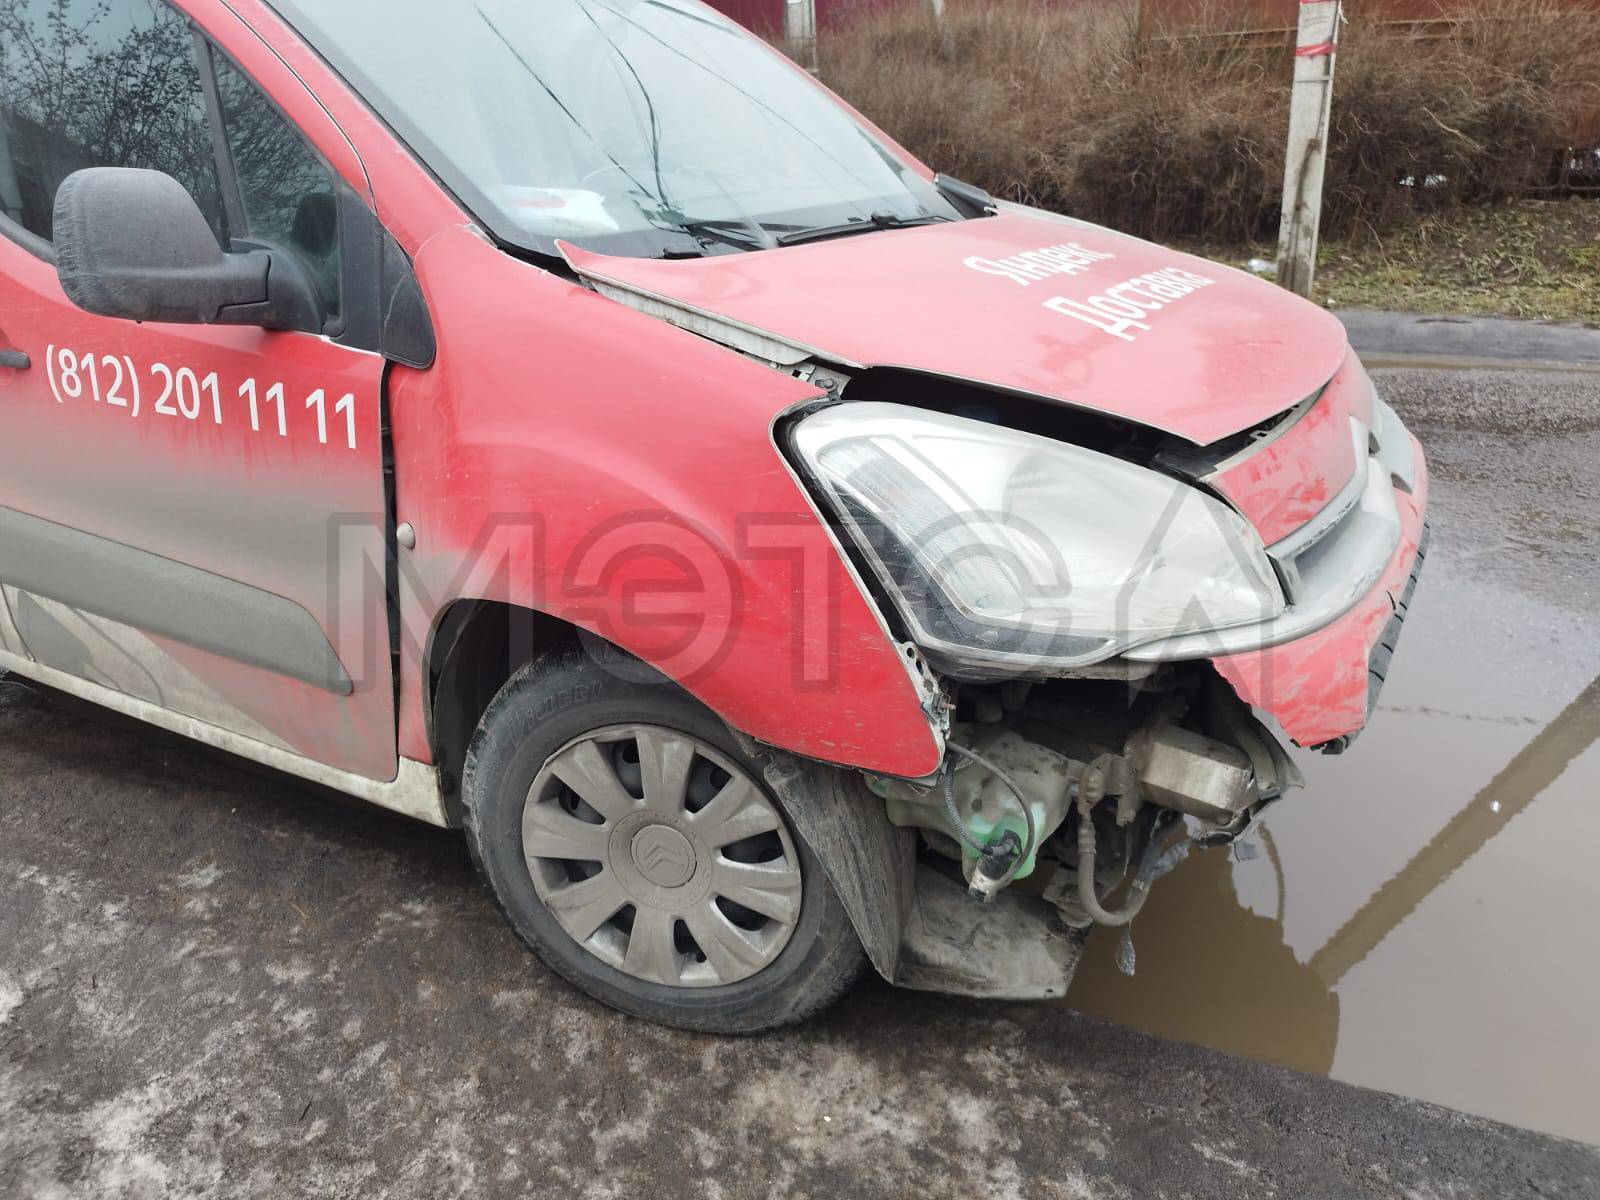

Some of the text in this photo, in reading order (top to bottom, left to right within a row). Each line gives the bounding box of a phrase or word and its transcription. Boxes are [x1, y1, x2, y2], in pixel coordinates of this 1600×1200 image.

[964, 242, 1116, 286] Яндекс
[1042, 267, 1216, 341] Доставка
[46, 344, 356, 449] (812) 201 11 11
